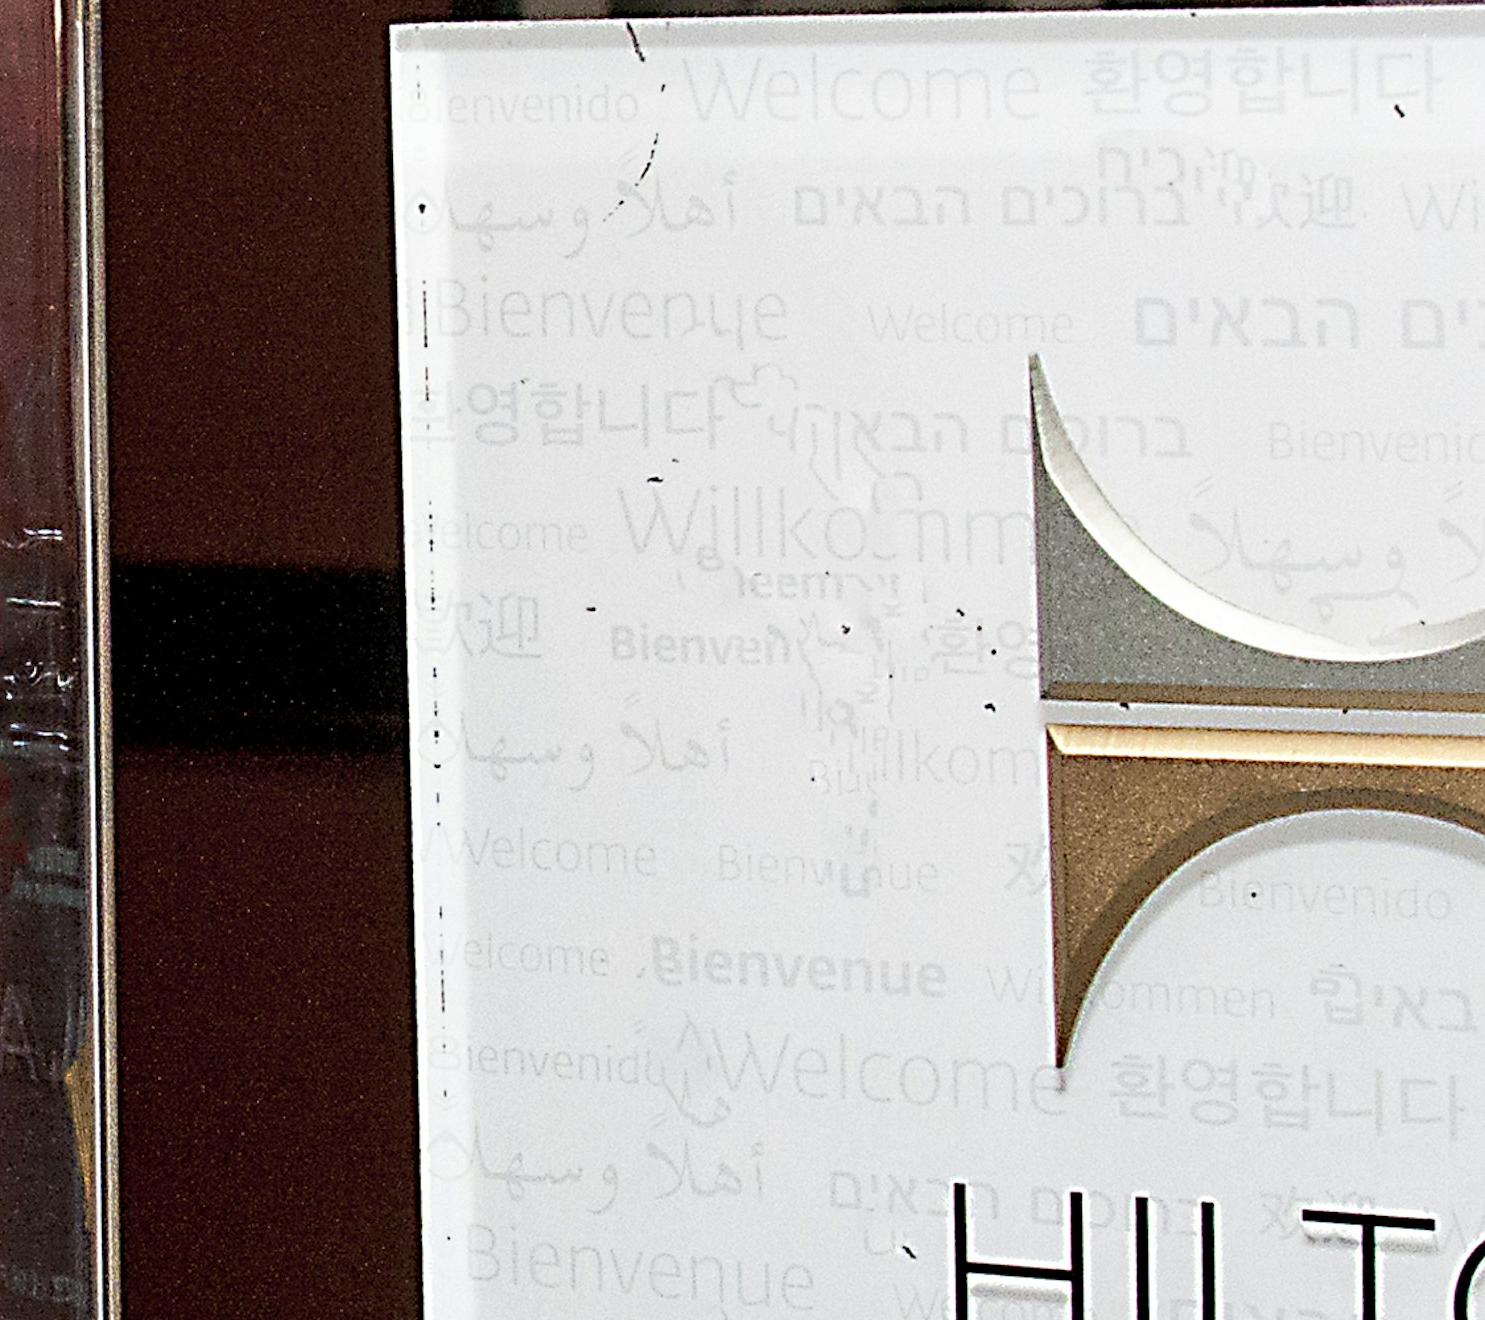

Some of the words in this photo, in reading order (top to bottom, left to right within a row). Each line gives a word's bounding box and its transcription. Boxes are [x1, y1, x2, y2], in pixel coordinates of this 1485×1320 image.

[682, 55, 1043, 122] Welcome
[1083, 43, 1444, 119] 환영합니다
[866, 301, 1077, 347] Welcome
[648, 933, 949, 1000] Bienvenue
[711, 1025, 1069, 1120] Welcome
[1109, 1050, 1468, 1143] 환영합니다
